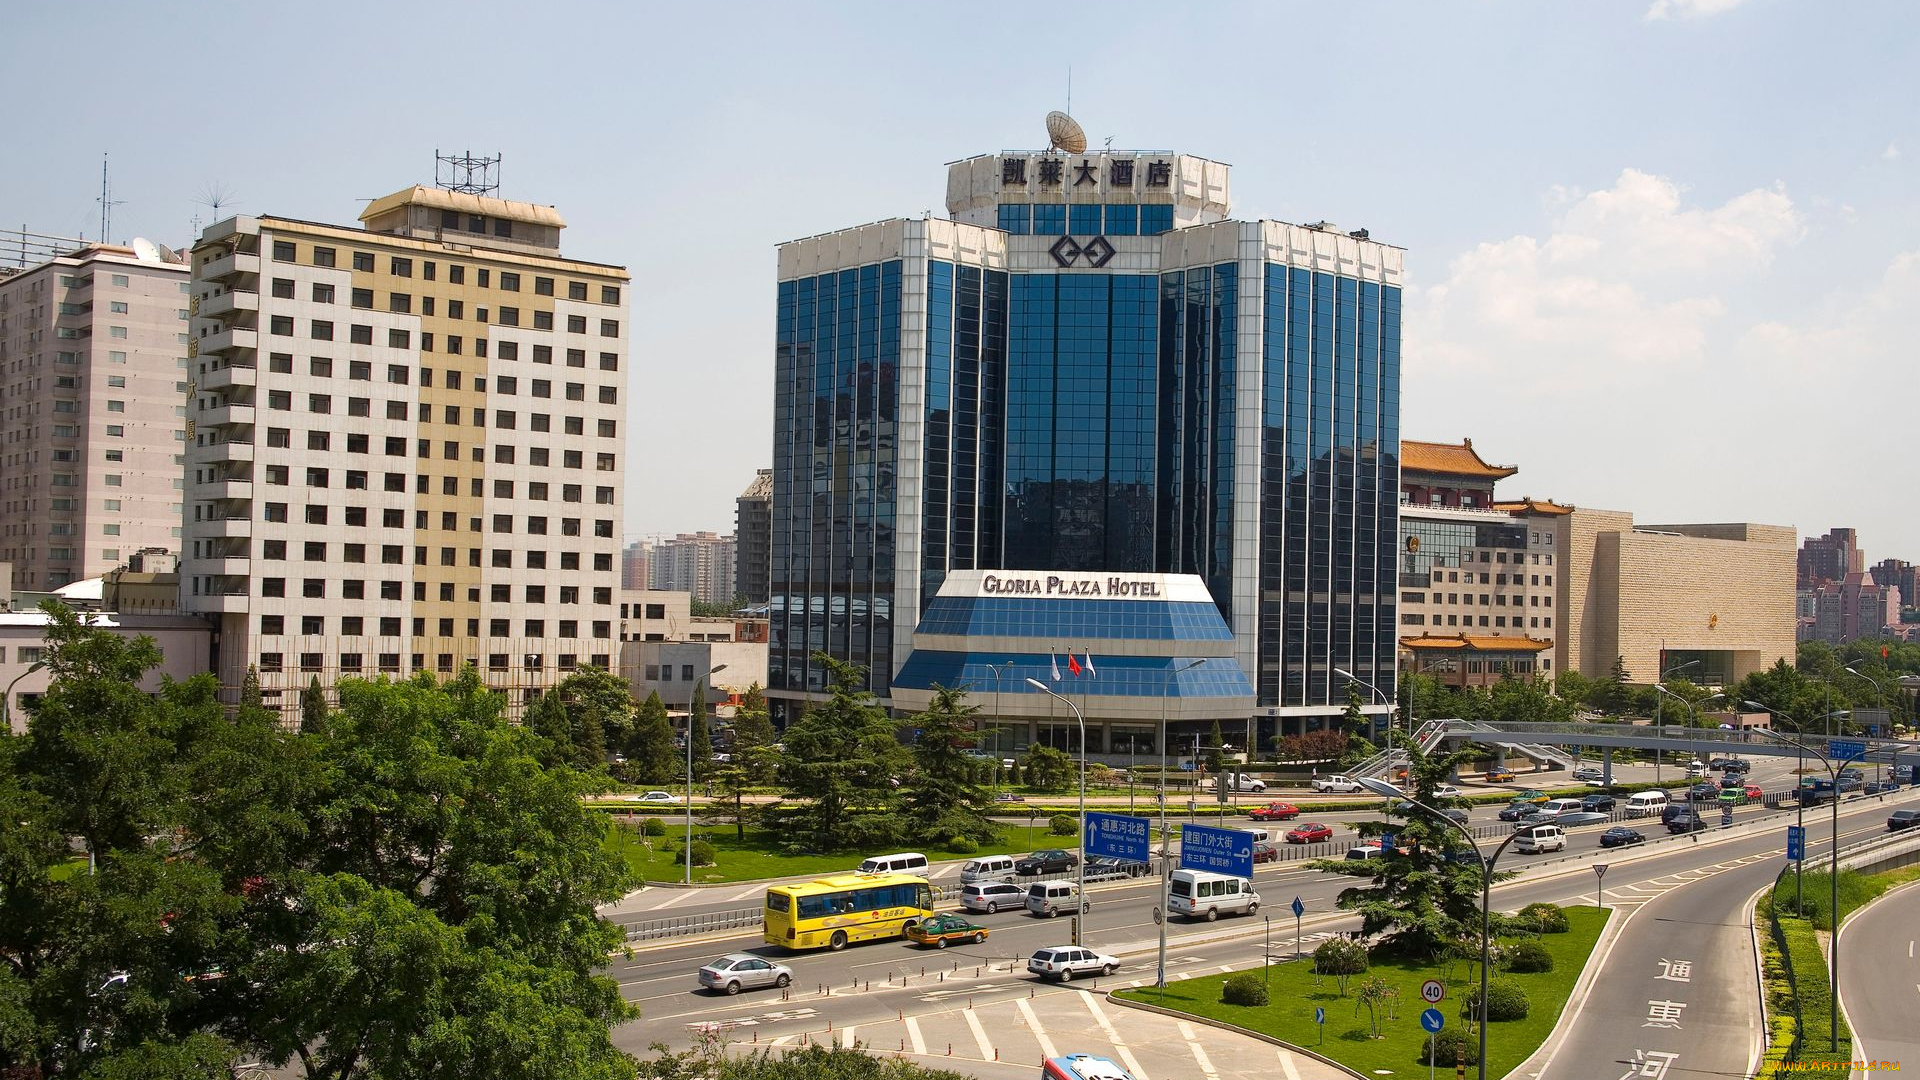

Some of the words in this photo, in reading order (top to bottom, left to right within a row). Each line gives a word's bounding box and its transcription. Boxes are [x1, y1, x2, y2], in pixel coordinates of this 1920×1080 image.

[1002, 157, 1171, 187] 凯莱大酒店
[983, 574, 1042, 594] GLORIA
[1046, 576, 1102, 596] PLAZA
[1106, 577, 1161, 597] HOTEL
[1101, 818, 1145, 836] 通惠河北路
[1184, 830, 1233, 849] 建国门外大街
[1426, 986, 1440, 997] 40
